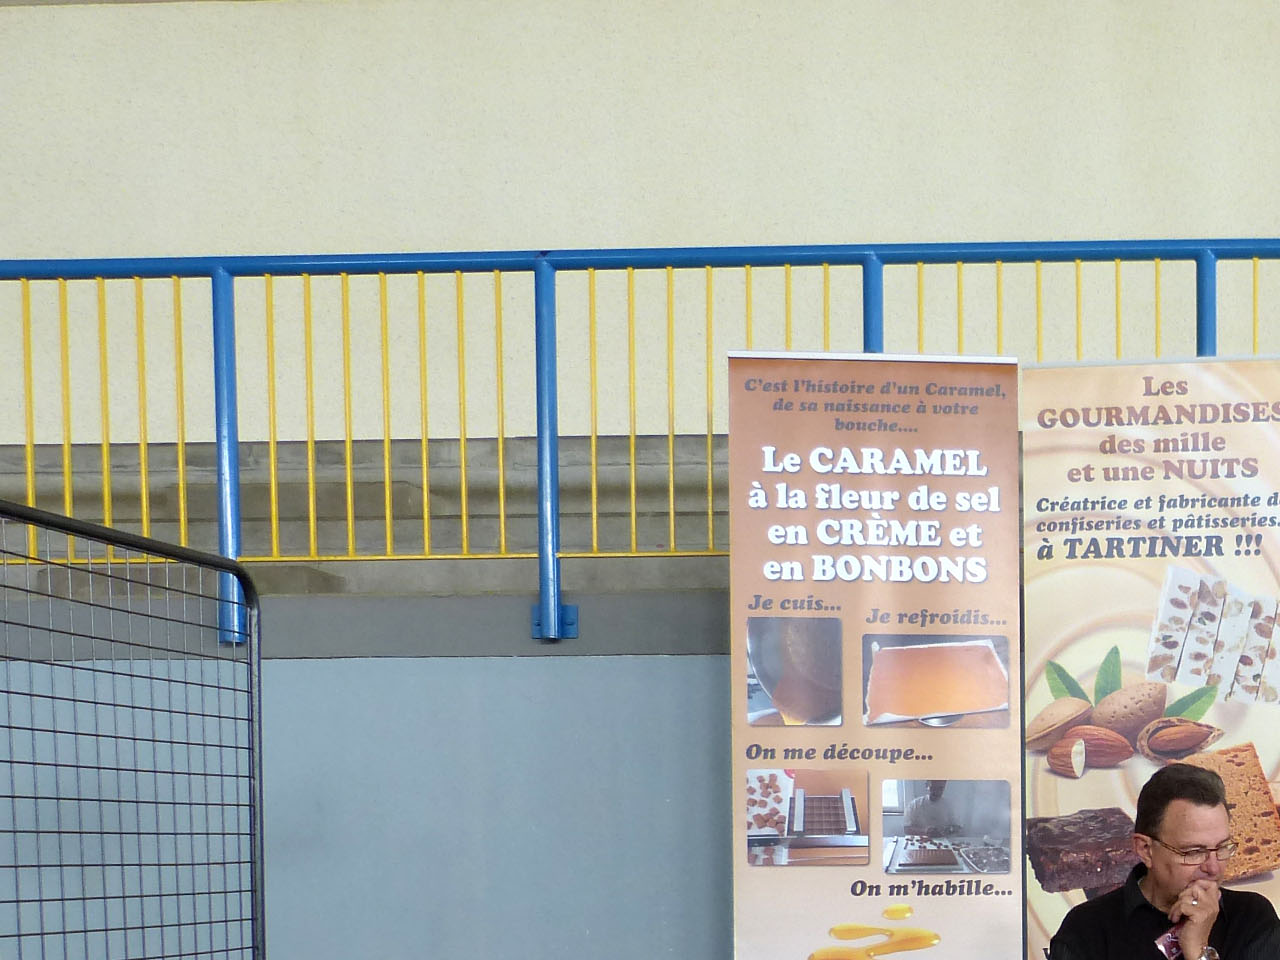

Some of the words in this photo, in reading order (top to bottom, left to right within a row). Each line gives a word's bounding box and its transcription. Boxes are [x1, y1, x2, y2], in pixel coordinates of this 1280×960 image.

[744, 378, 787, 393] C'est
[793, 379, 875, 395] l'histoire
[880, 381, 919, 395] d'un
[925, 382, 1007, 400] Caramel,
[1142, 375, 1188, 397] Les
[773, 398, 793, 411] de
[800, 401, 818, 412] sa
[824, 399, 910, 414] naissance
[916, 399, 927, 414] à
[932, 402, 979, 415] votre
[1099, 435, 1145, 455] des
[1153, 432, 1226, 453] mille
[762, 446, 801, 473] Le
[809, 447, 988, 477] CARAMEL
[1067, 464, 1095, 483] et
[1103, 464, 1155, 481] une
[1162, 457, 1259, 480] NUITS
[748, 481, 768, 509] à
[776, 483, 808, 510] la
[815, 483, 900, 511] fleur
[908, 485, 948, 511] de
[955, 486, 1001, 513] sel
[1036, 495, 1128, 513] Créatrice
[1133, 496, 1152, 510] et
[1158, 493, 1261, 513] fabricante
[767, 525, 808, 546] en
[816, 513, 942, 547] CRÈME
[949, 523, 983, 547] et
[1036, 515, 1142, 535] confiseries
[1147, 517, 1165, 530] et
[1037, 538, 1054, 560] à
[1063, 535, 1225, 560] TARTINER
[1234, 533, 1263, 557] !!!
[763, 559, 804, 581] en
[812, 554, 988, 584] BONBONS
[748, 595, 773, 611] Je
[780, 595, 842, 612] cuis...
[865, 608, 891, 625] Je
[897, 609, 1007, 628] refroidis...
[746, 744, 776, 760] On
[783, 746, 817, 760] me
[823, 744, 933, 764] découpe...
[851, 880, 882, 897] On
[888, 879, 1013, 897] m'habille...
